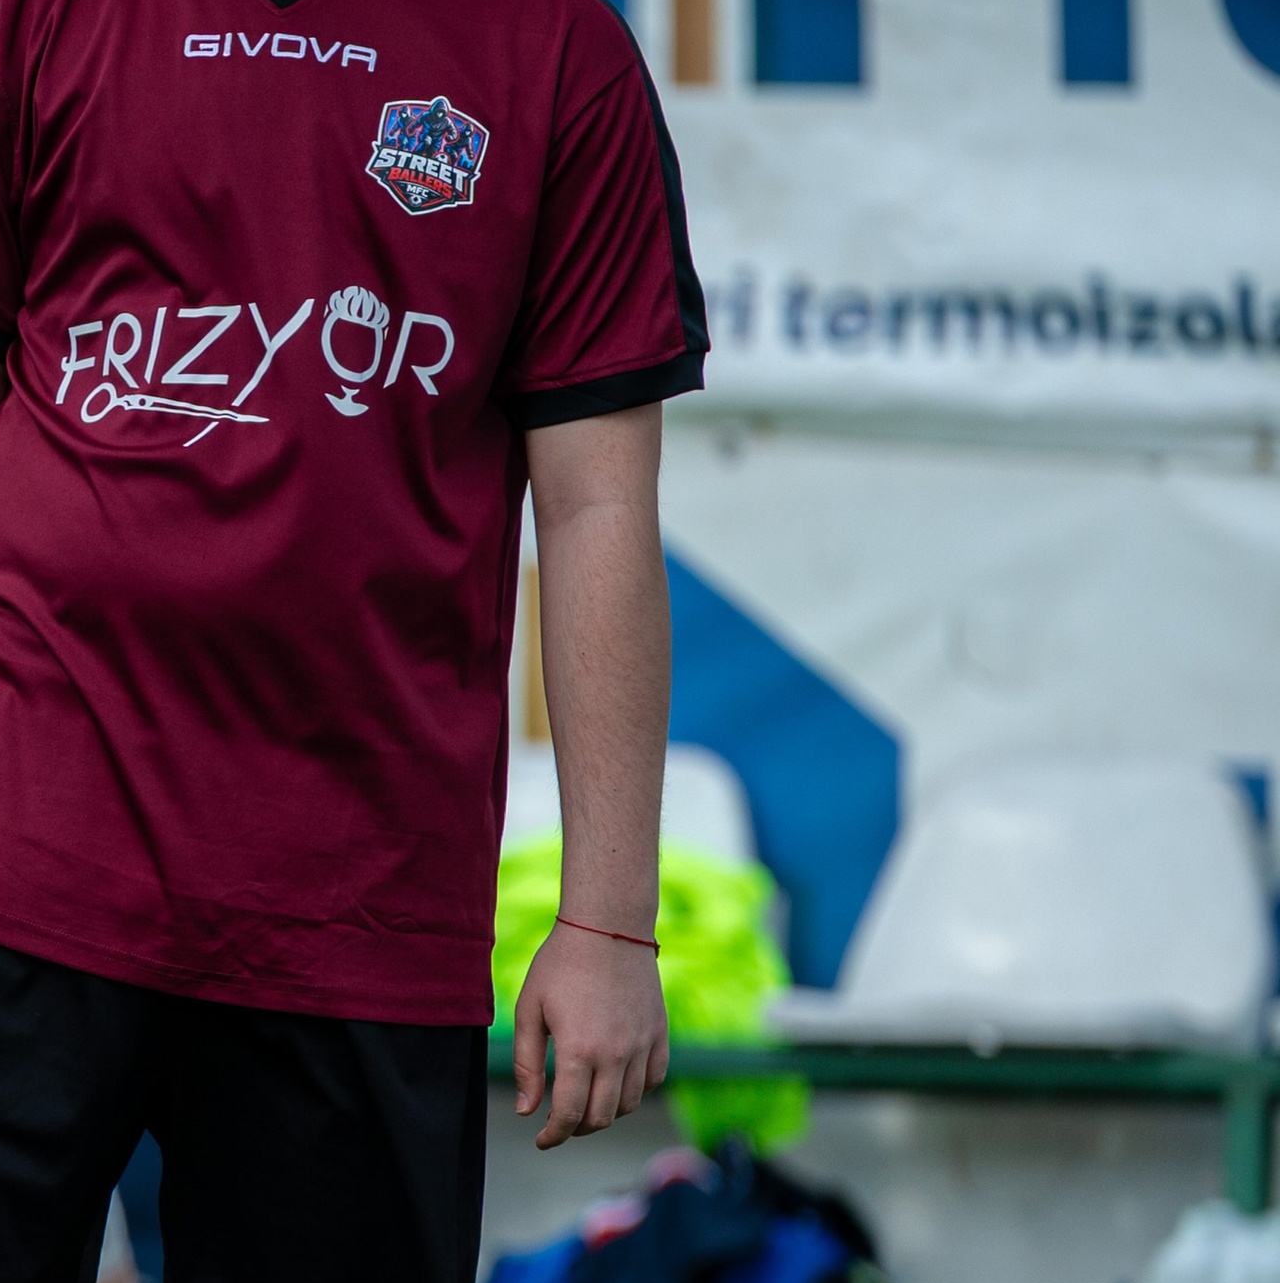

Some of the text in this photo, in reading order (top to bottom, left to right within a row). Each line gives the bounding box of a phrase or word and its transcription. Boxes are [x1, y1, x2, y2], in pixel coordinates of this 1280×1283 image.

[183, 31, 378, 73] GIVOVA
[373, 147, 469, 192] STREET
[387, 166, 454, 199] BALLERS
[406, 184, 430, 198] MFC
[781, 266, 1280, 358] termoizol
